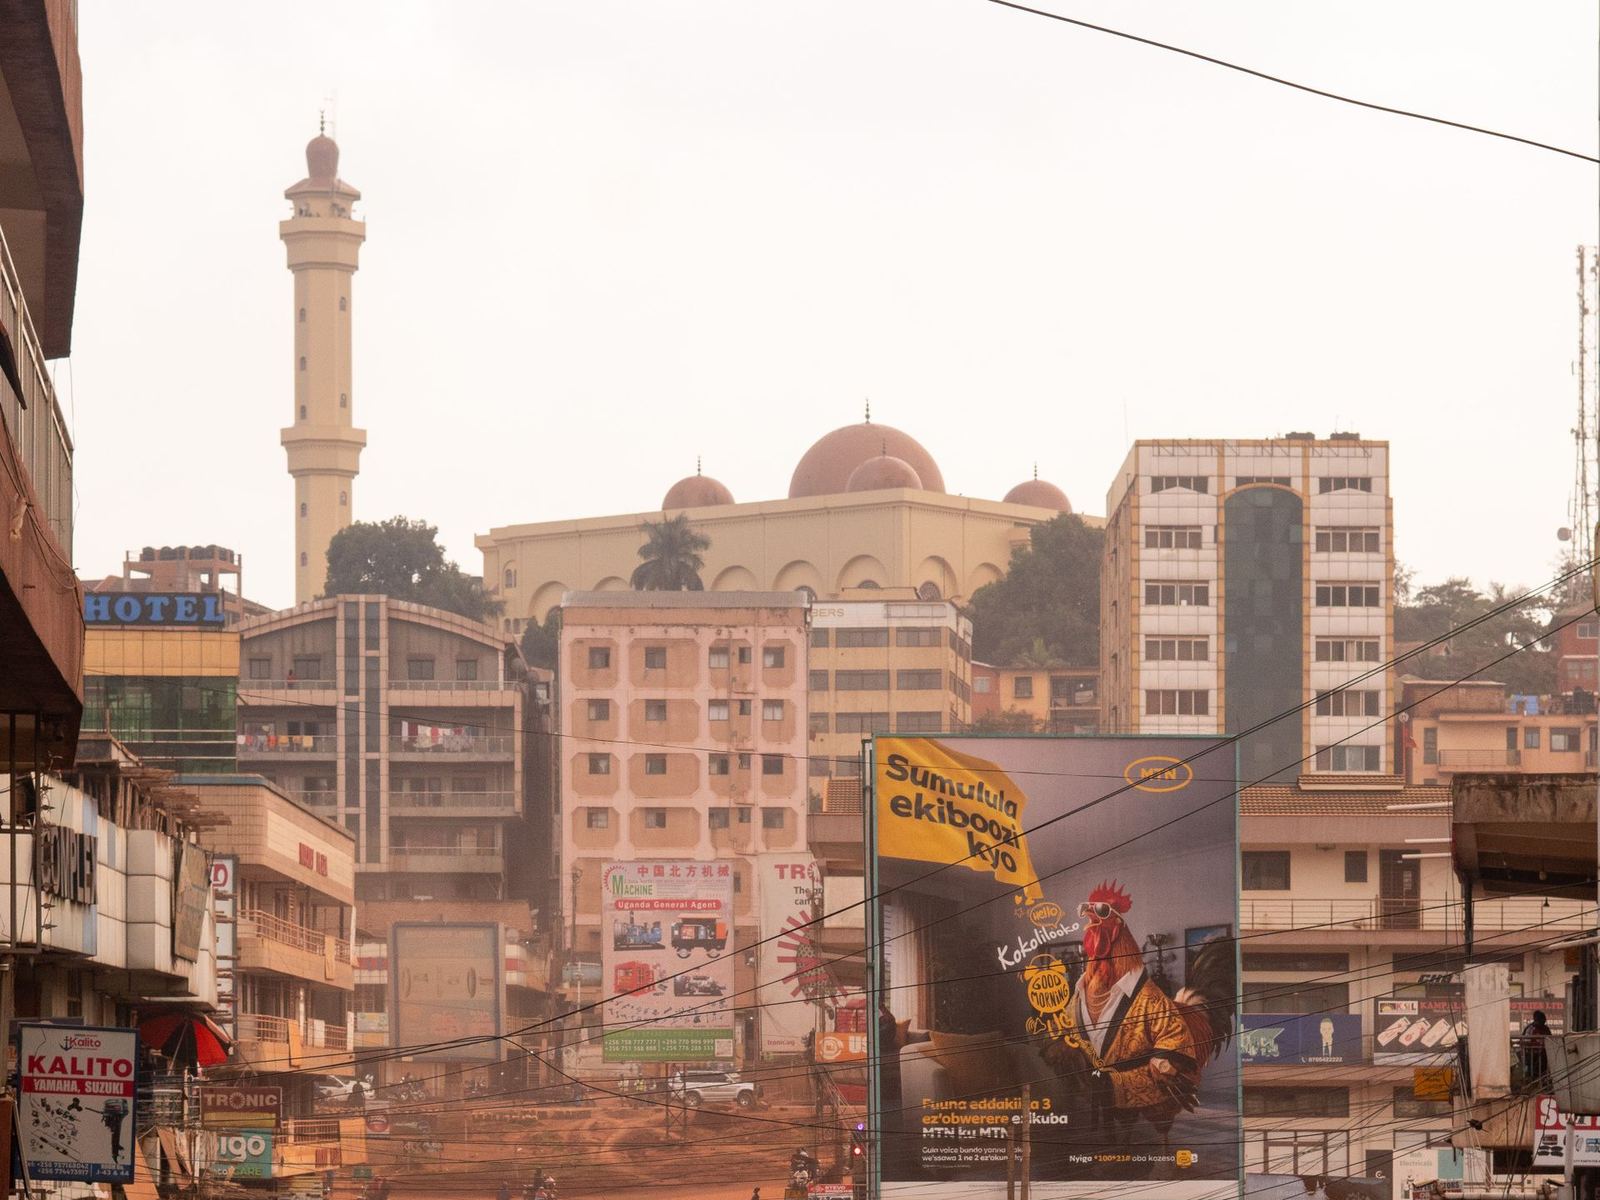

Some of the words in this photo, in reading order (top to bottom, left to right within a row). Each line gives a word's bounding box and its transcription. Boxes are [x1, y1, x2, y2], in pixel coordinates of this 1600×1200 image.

[84, 595, 225, 622] HOTEL
[1140, 767, 1176, 780] MTN
[886, 754, 1018, 819] Sumulula
[890, 793, 1020, 849] ekiboozi
[967, 831, 1017, 872] kyo
[637, 865, 730, 877] 中国北方机械
[618, 902, 650, 910] Uganda
[654, 901, 688, 909] General
[691, 902, 717, 910] Agent
[998, 923, 1079, 970] Kokolilooko
[1032, 974, 1061, 990] GOOD
[69, 1037, 101, 1047] Kalito
[28, 1055, 133, 1078] KALITO
[34, 1079, 80, 1092] YAMAHA,
[85, 1080, 124, 1094] SUZUKI
[204, 1092, 277, 1109] TRONIC
[1042, 1098, 1051, 1110] 3
[922, 1112, 1008, 1124] ez'obwerere
[922, 1127, 955, 1138] MTN
